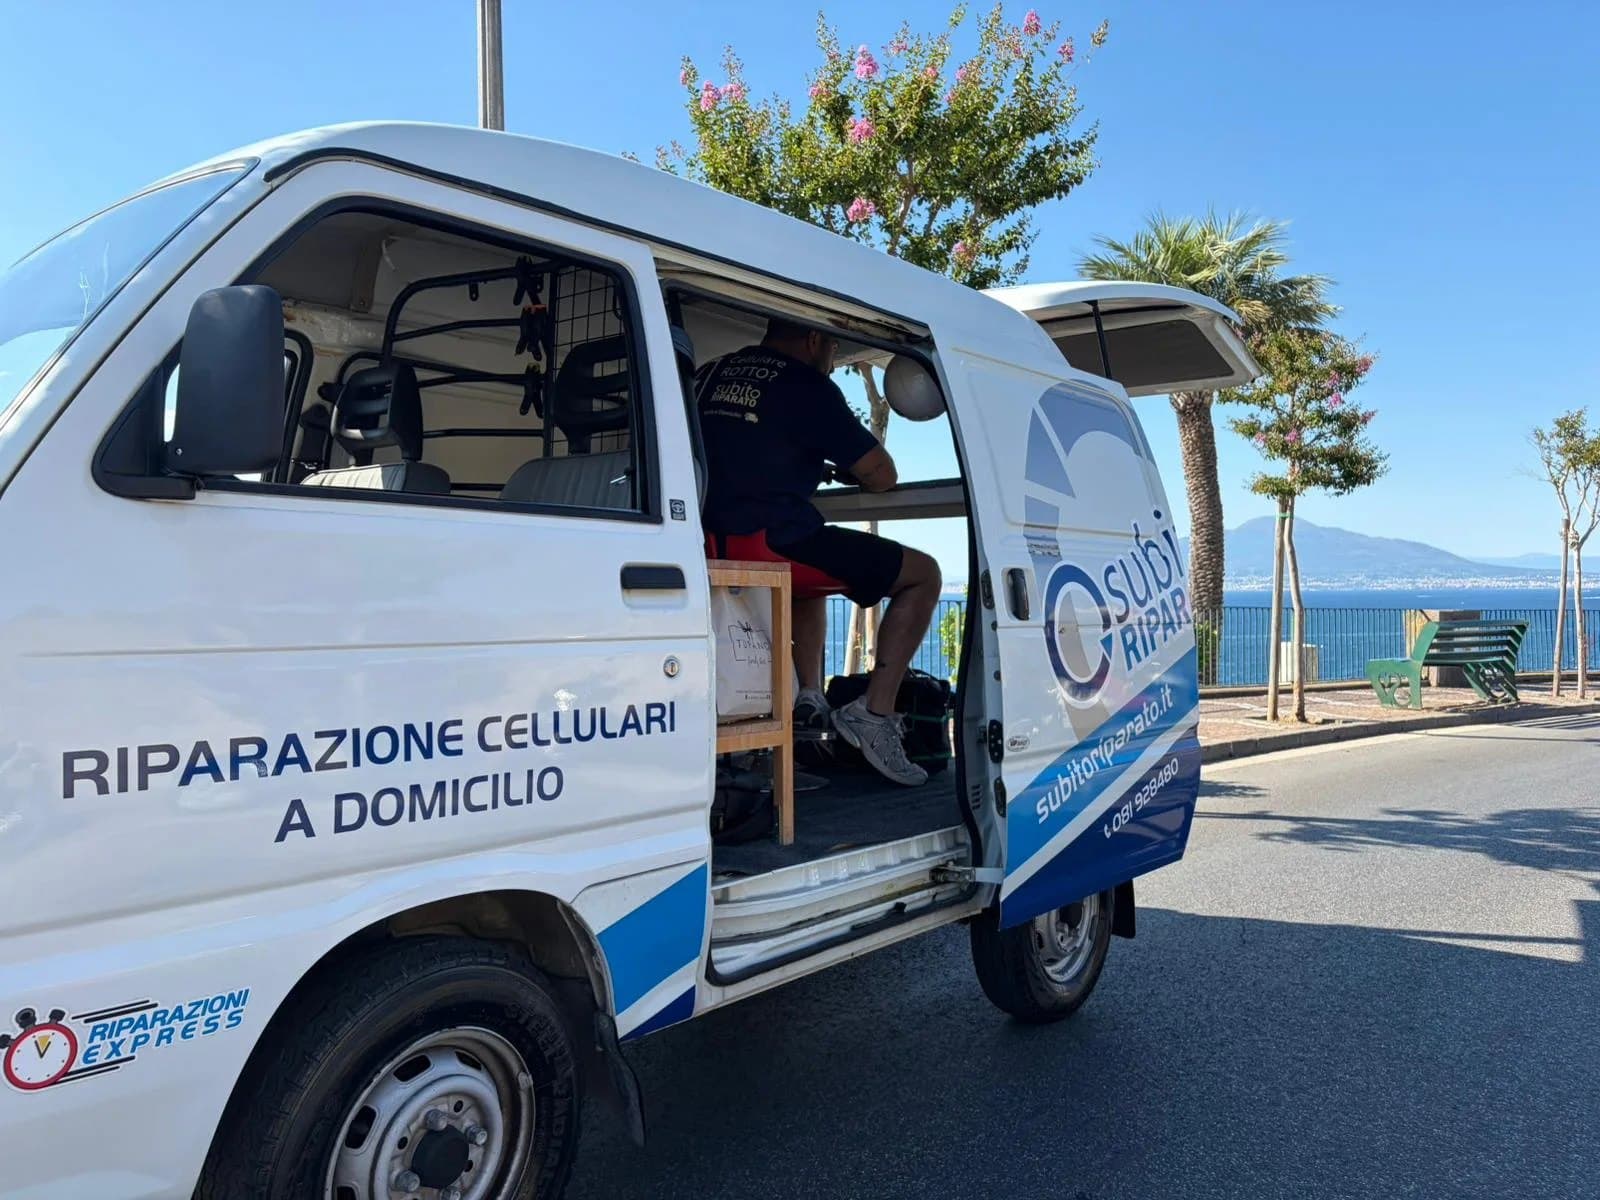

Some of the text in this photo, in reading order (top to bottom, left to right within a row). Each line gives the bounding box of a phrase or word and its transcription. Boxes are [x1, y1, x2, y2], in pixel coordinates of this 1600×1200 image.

[715, 380, 761, 399] subito
[719, 366, 779, 383] ROTTO?
[62, 701, 676, 799] RIPARAZIONE CELLULARI
[1036, 685, 1174, 825] subitoriparato.it
[274, 767, 564, 843] A DOMICILIO
[1112, 757, 1179, 832] 081 928480
[82, 1008, 244, 1065] EXPRESS
[88, 988, 250, 1044] RIPARAZIONI
